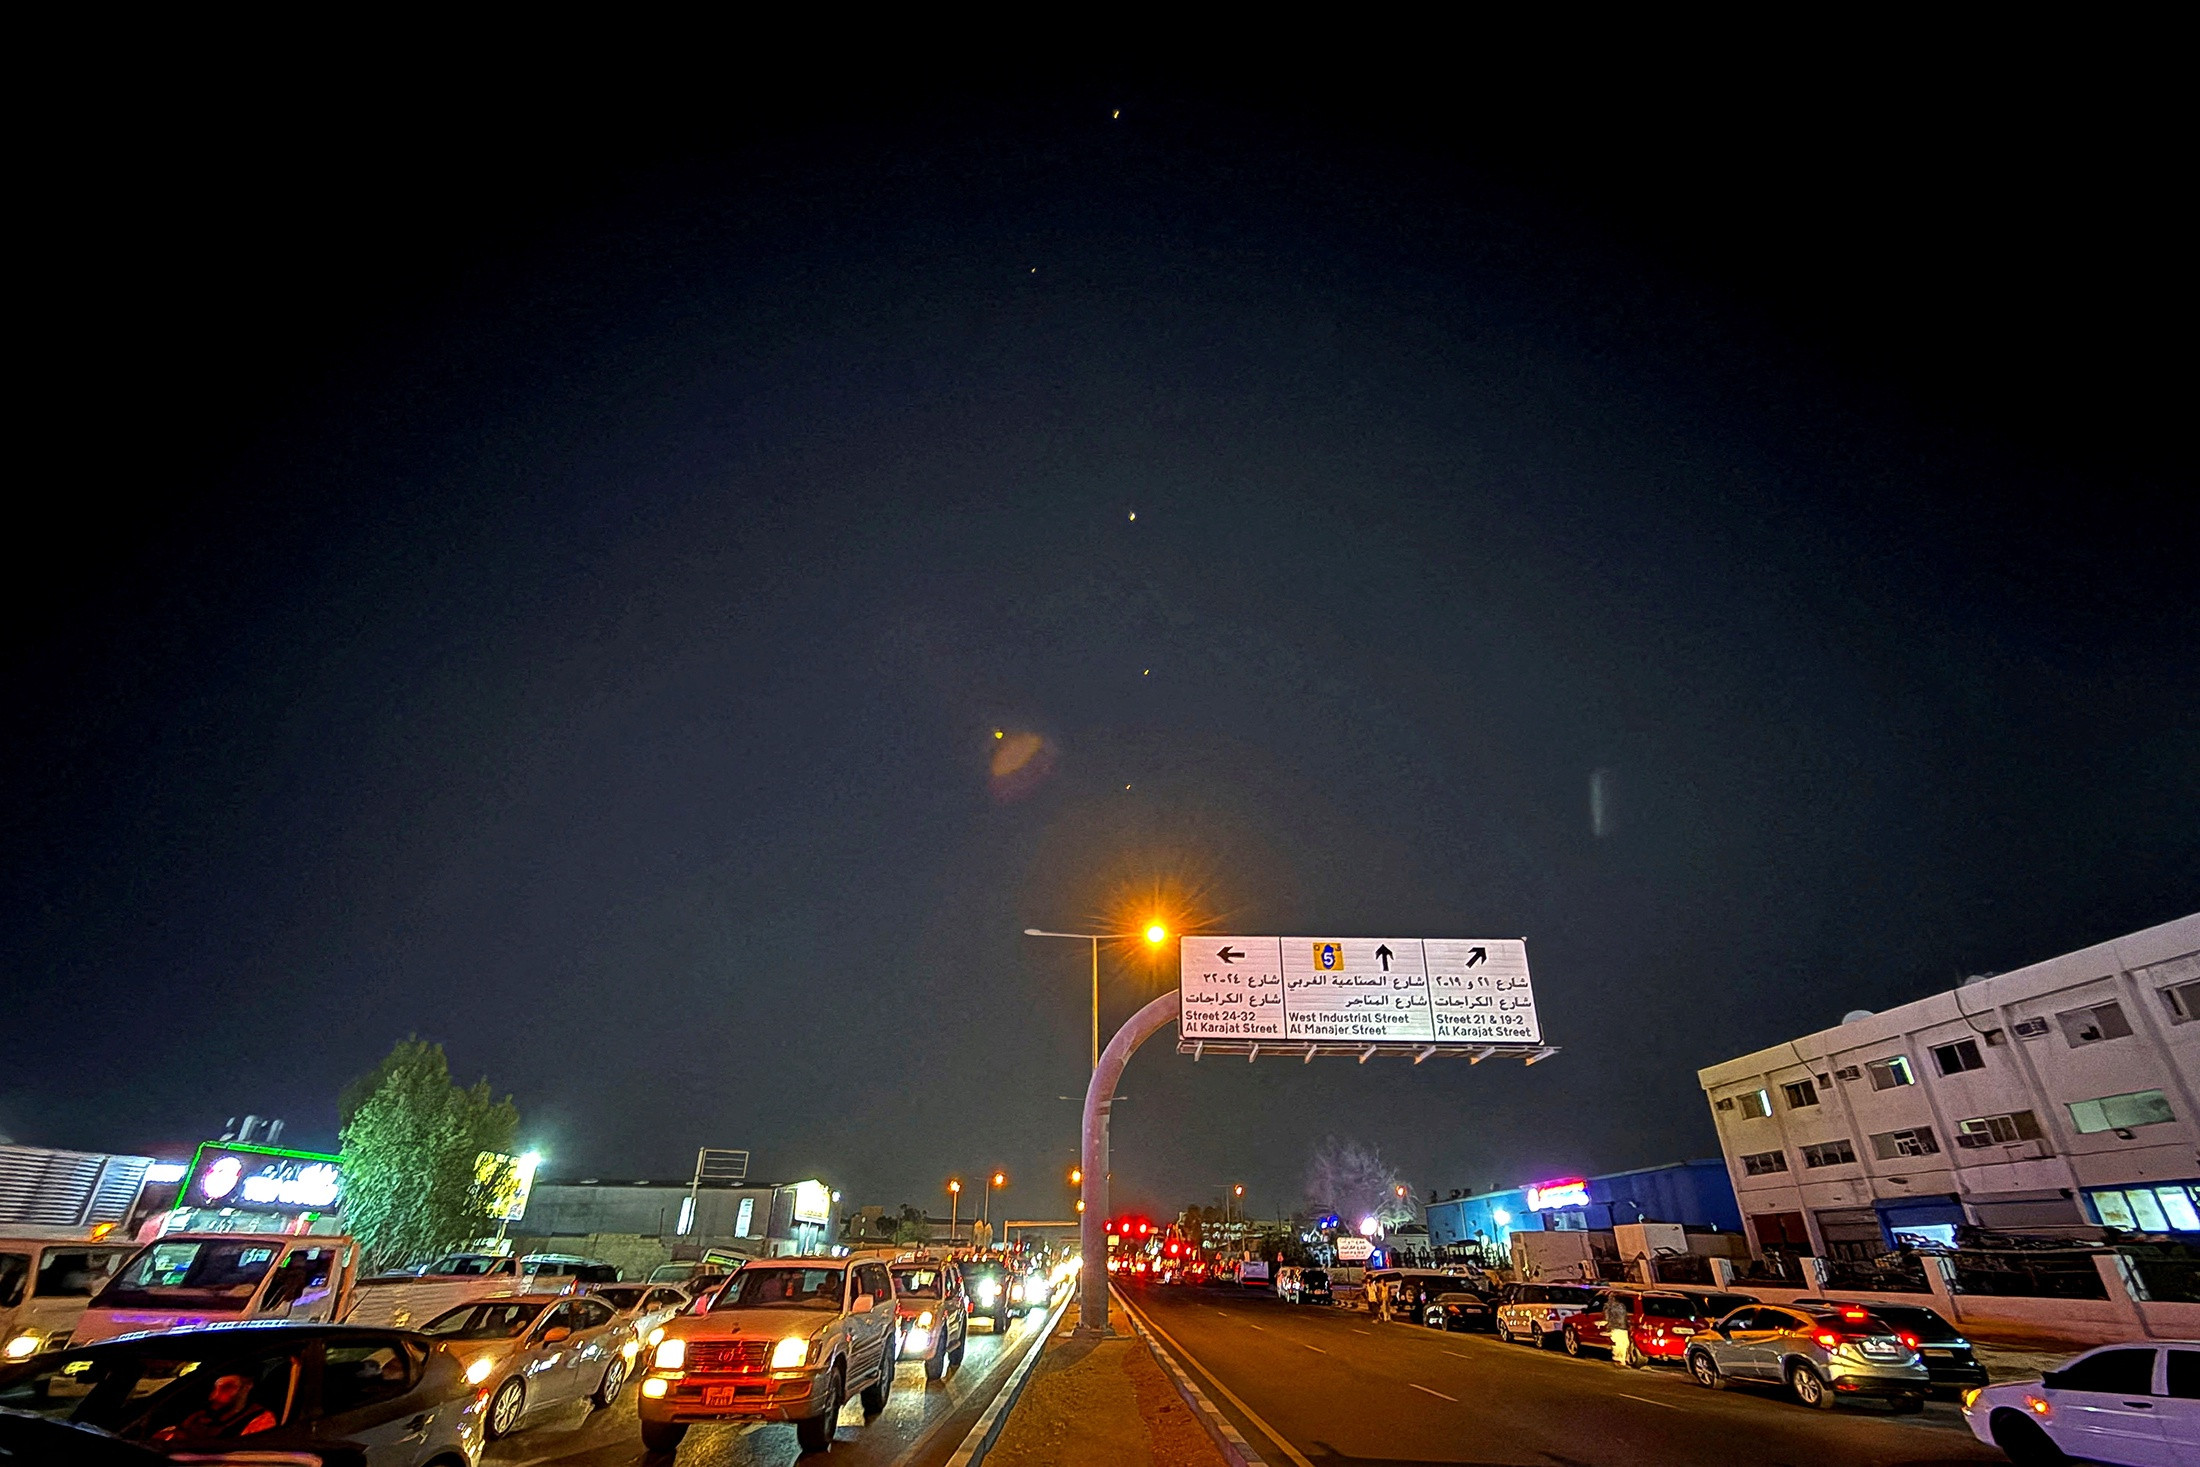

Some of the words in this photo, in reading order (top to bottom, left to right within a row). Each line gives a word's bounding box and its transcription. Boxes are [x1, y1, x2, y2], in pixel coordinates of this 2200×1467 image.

[1323, 952, 1334, 965] 5
[1248, 974, 1280, 988] شارع
[1287, 975, 1327, 991] الغربي
[1332, 975, 1387, 988] الصناعية
[1393, 976, 1425, 990] شارع
[1467, 980, 1474, 990] و
[1496, 977, 1529, 991] شارع
[1185, 992, 1243, 1006] الكراجات
[1249, 993, 1281, 1007] شارع
[1345, 995, 1389, 1007] المتاجر
[1395, 995, 1427, 1009] شارع
[1434, 996, 1493, 1009] الكراجات
[1499, 996, 1532, 1010] شارع
[1185, 1010, 1219, 1021] Street
[1222, 1011, 1256, 1022] 24-32
[1288, 1012, 1317, 1023] West
[1320, 1013, 1371, 1023] Industrial
[1375, 1013, 1409, 1024] Street
[1436, 1014, 1471, 1024] Street
[1473, 1014, 1486, 1025] 21
[1490, 1015, 1497, 1025] &
[1500, 1014, 1524, 1025] 19-2
[1185, 1022, 1198, 1032] Al
[1201, 1022, 1240, 1034] Karajat
[1243, 1023, 1278, 1034] Street
[1290, 1024, 1302, 1034] Al
[1305, 1024, 1349, 1036] Manajer
[1352, 1025, 1387, 1035] Street
[1437, 1025, 1450, 1036] Al
[1453, 1026, 1493, 1037] Karajat
[1496, 1026, 1532, 1037] Street
